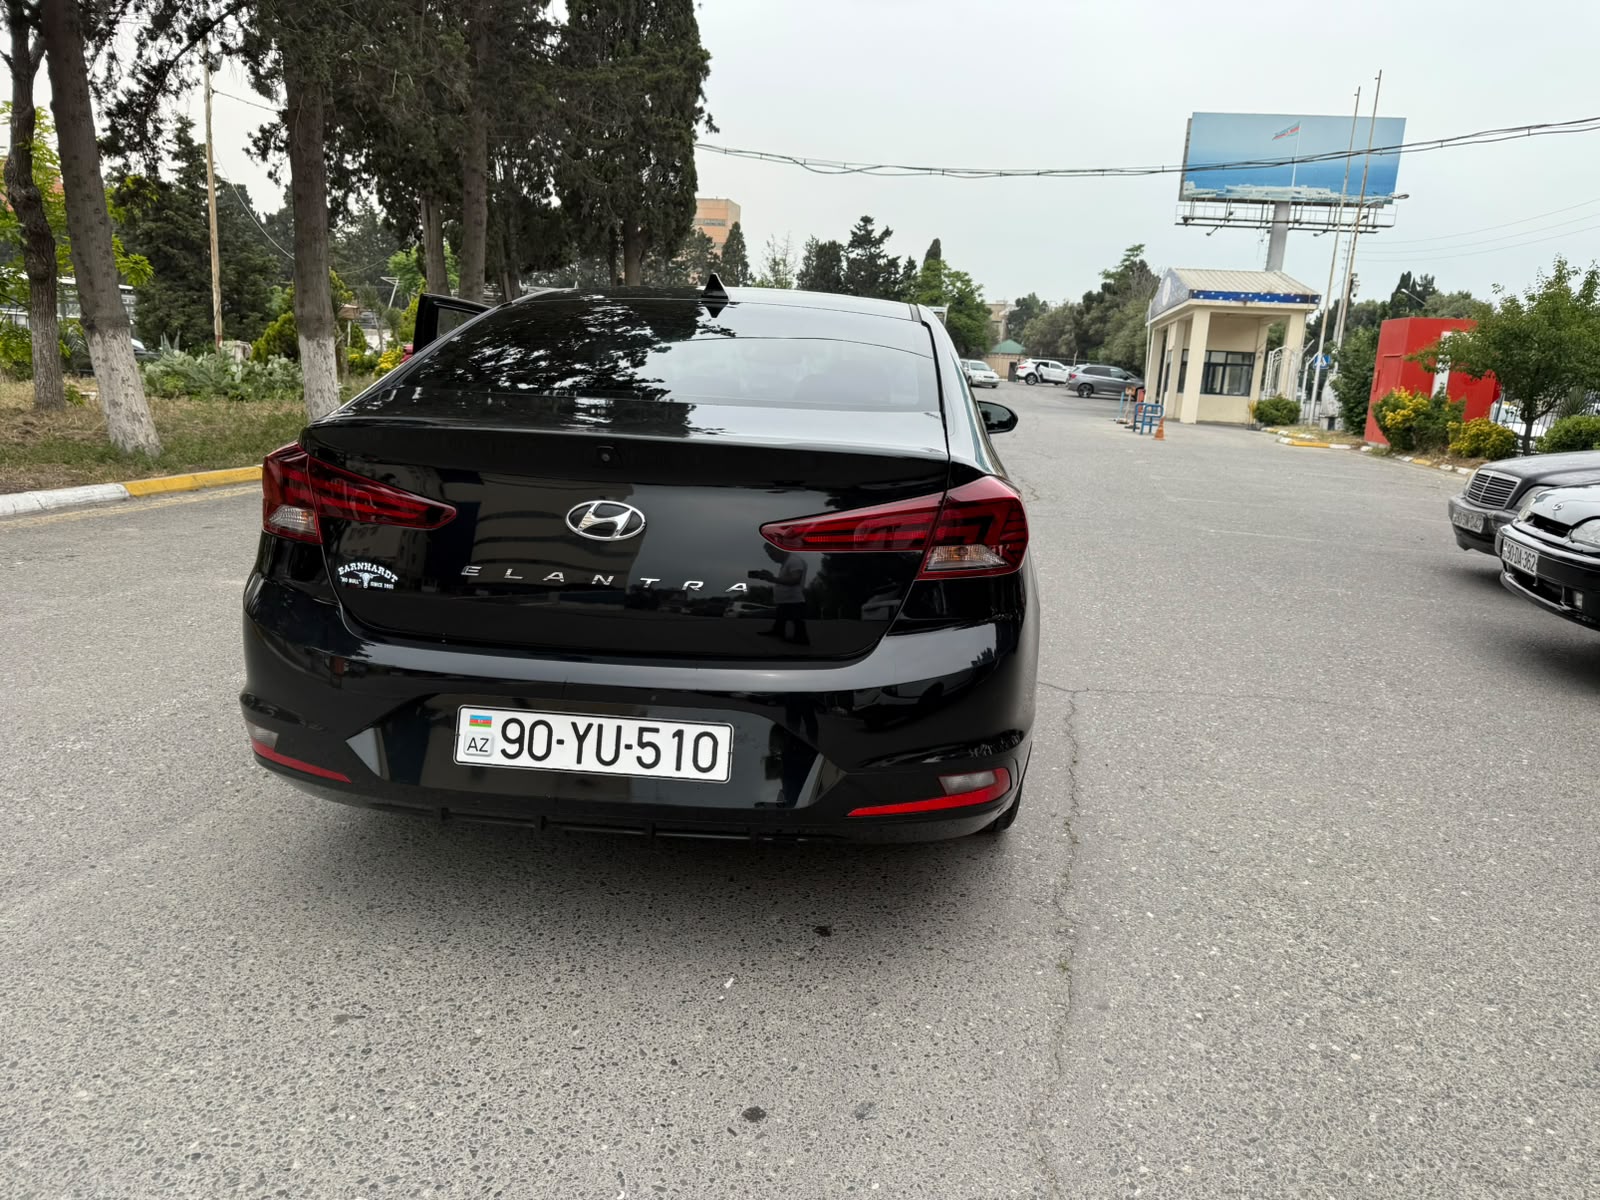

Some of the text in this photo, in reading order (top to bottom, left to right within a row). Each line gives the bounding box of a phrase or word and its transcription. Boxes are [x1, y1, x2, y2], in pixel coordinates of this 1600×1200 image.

[338, 562, 398, 582] EARNHARDT
[460, 565, 748, 593] ELANTRA
[466, 737, 490, 753] AZ
[500, 717, 719, 773] 90-YU-510
